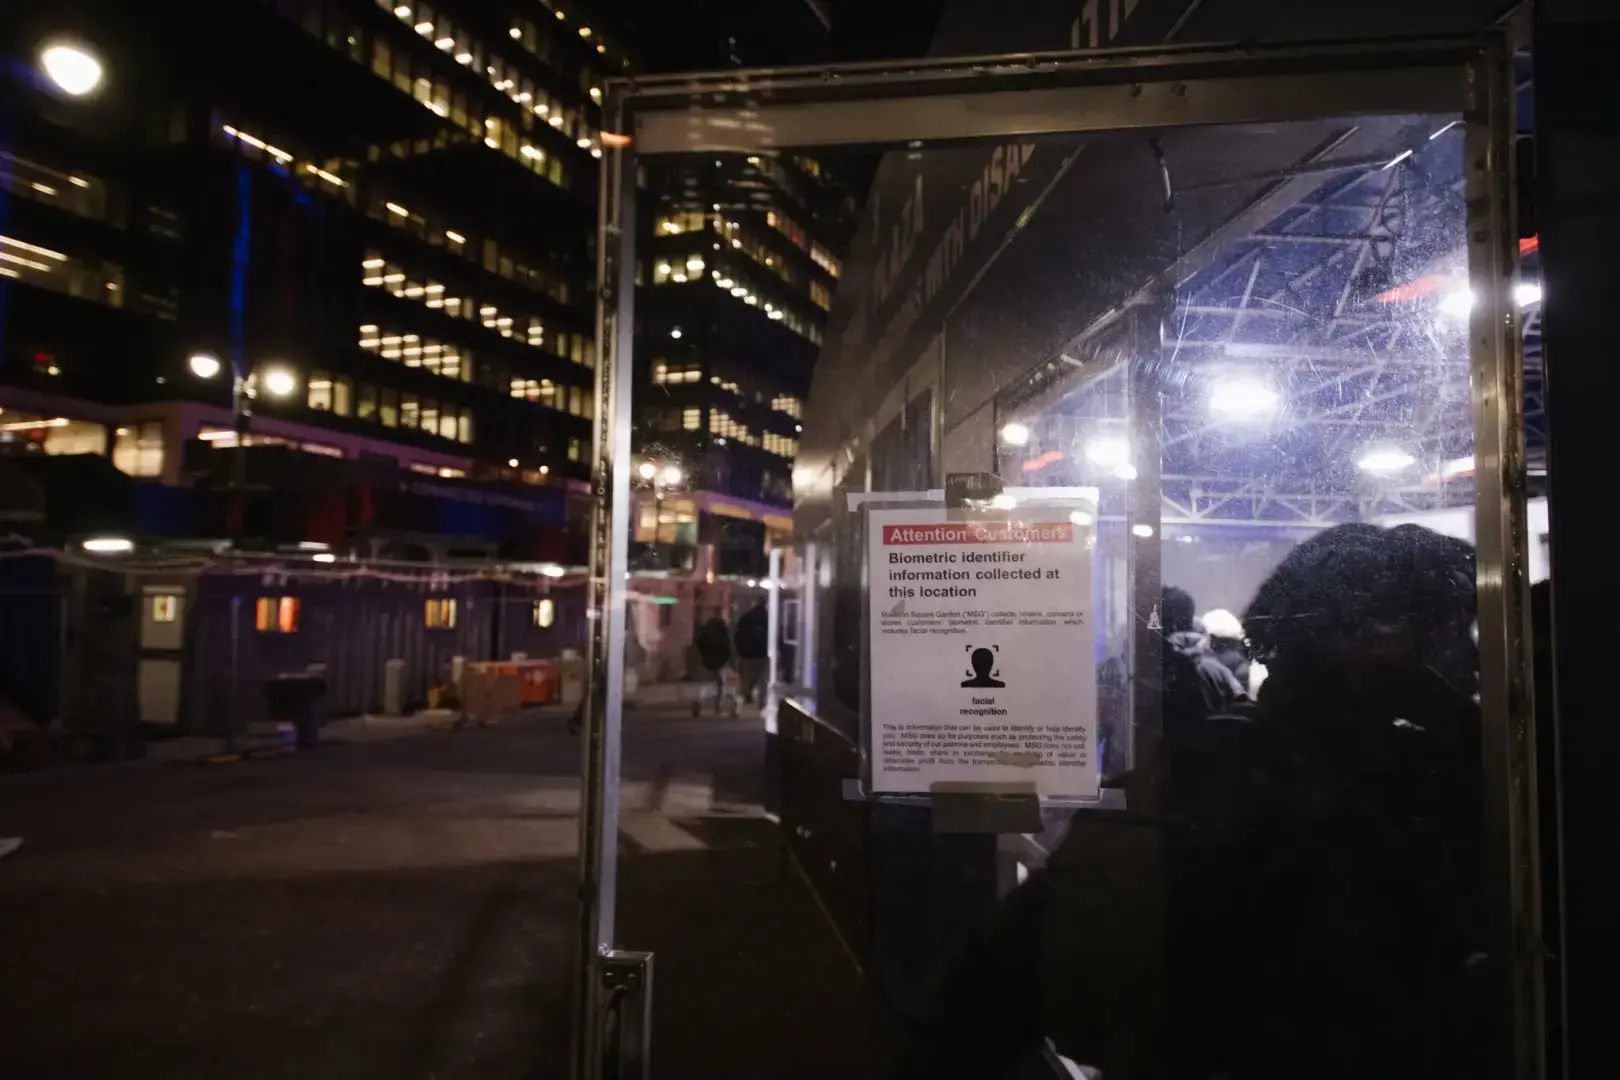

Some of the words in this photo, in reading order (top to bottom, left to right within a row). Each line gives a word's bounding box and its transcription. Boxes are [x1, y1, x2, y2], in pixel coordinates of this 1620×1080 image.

[890, 527, 967, 542] Attention
[975, 525, 1067, 541] Customers
[889, 552, 957, 564] Biometric
[962, 551, 1026, 563] identifier
[889, 569, 970, 581] information
[976, 568, 1041, 580] collected
[1046, 568, 1060, 580] at
[889, 586, 915, 598] this
[920, 585, 977, 598] location
[910, 611, 935, 619] Square
[972, 697, 995, 705] facial
[960, 707, 1008, 717] recognition
[882, 723, 897, 731] This
